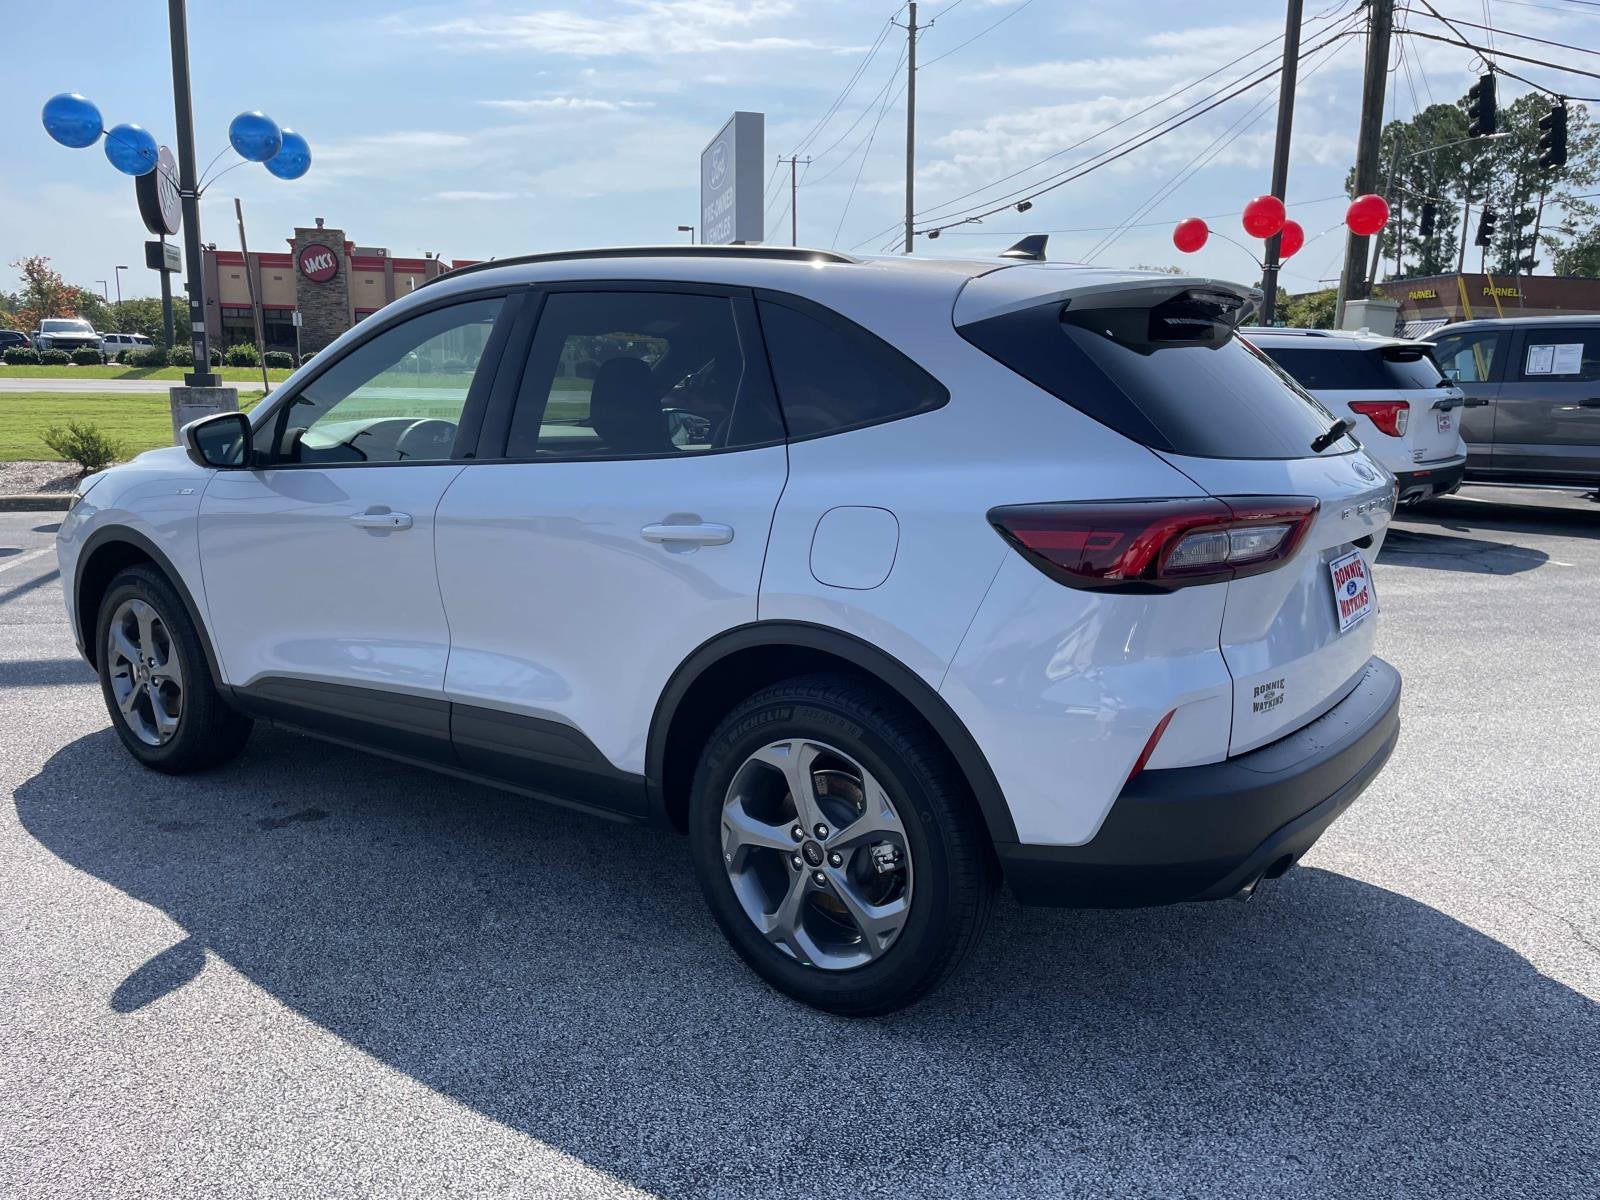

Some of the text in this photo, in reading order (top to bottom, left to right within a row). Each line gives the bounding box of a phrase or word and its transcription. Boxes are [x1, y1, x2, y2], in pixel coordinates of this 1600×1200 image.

[1408, 289, 1437, 300] PARNELL
[1482, 287, 1523, 297] PARNELL
[1333, 559, 1365, 593] RONNIE
[1340, 585, 1369, 619] WATKINS
[1253, 678, 1285, 699] RONNIE
[1252, 693, 1284, 713] WATKINS
[728, 709, 790, 742] MICHELIN
